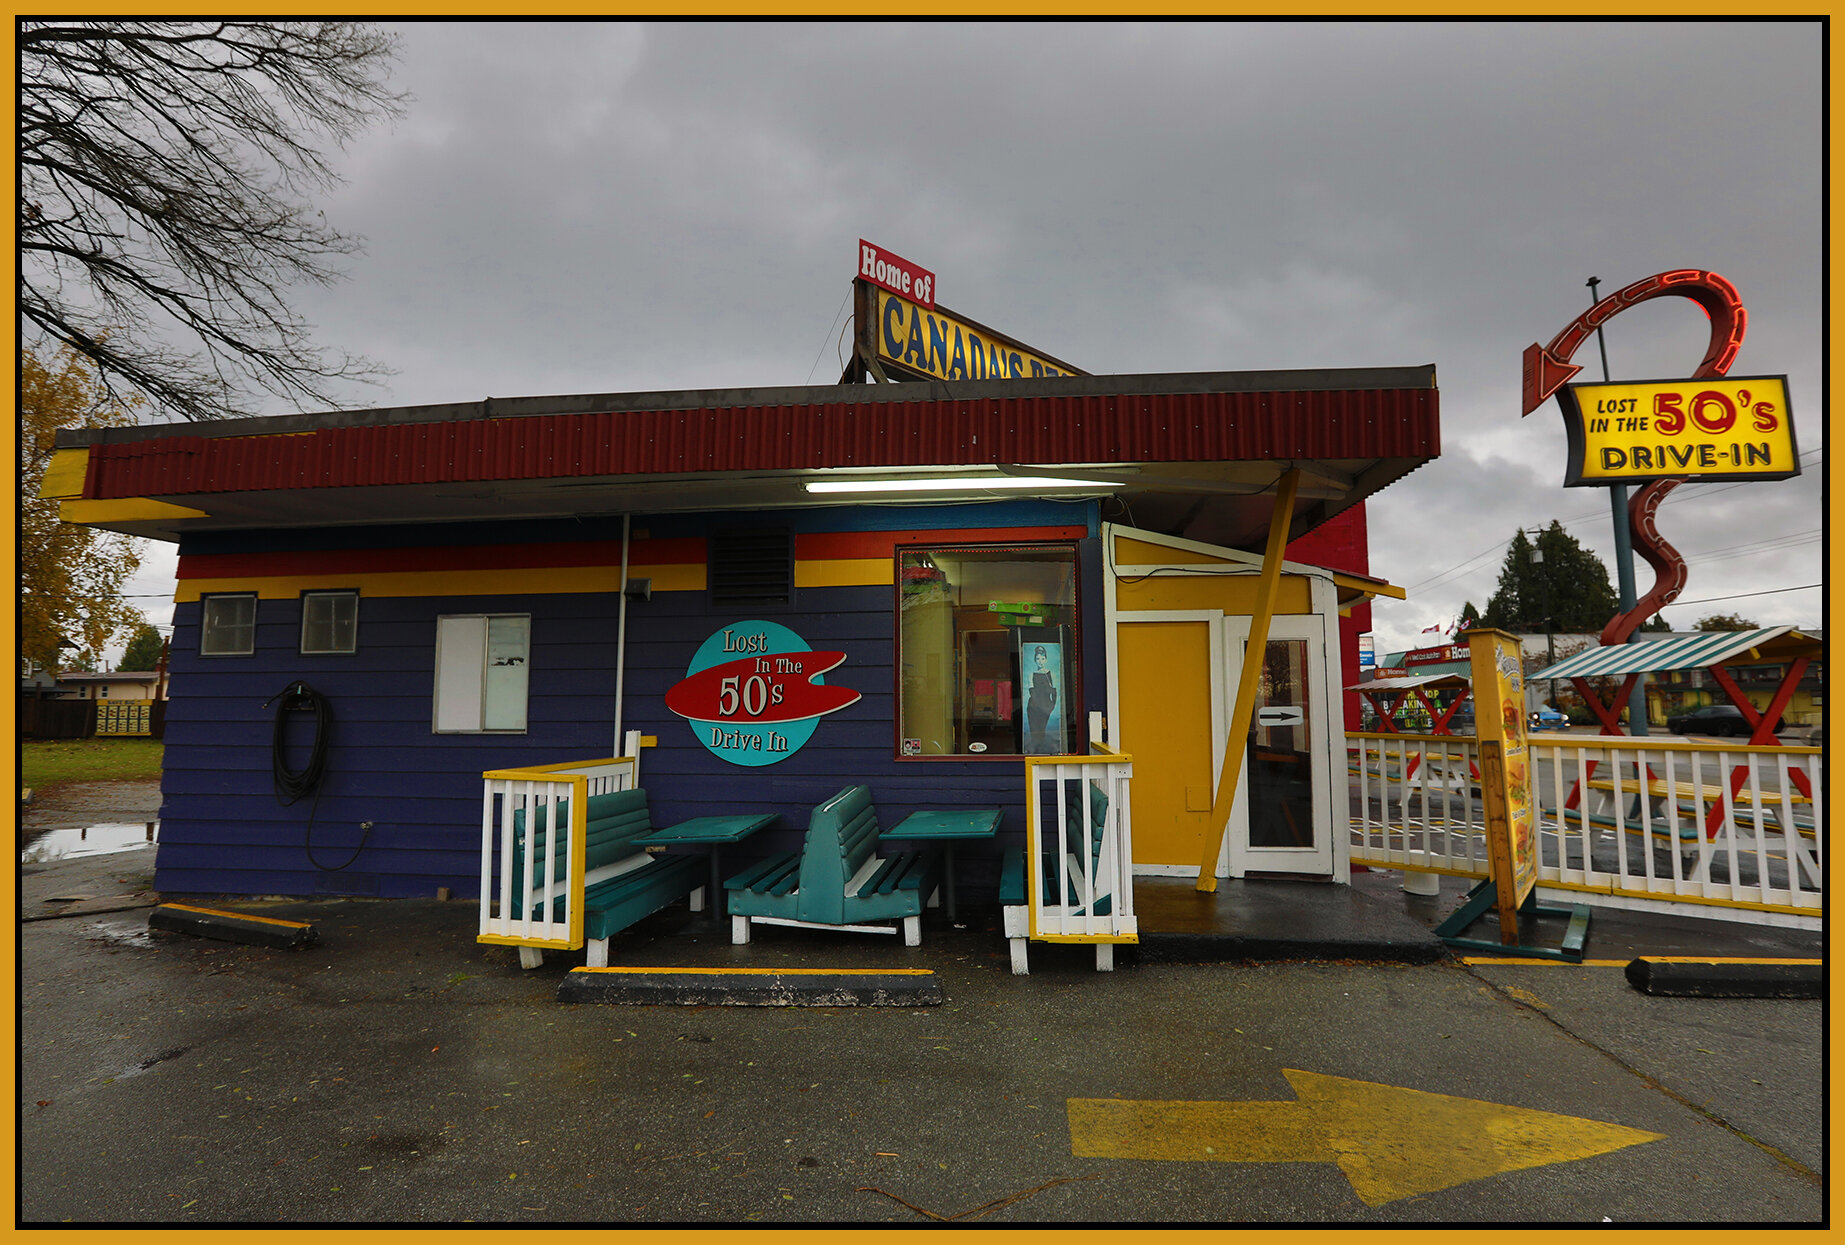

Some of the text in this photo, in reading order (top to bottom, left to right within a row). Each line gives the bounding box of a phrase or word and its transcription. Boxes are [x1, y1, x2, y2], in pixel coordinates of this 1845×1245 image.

[861, 245, 932, 304] Home of
[1596, 398, 1638, 414] LOST
[1589, 416, 1648, 433] IN THE
[1601, 442, 1772, 470] DRIVE-IN
[722, 630, 768, 653] Lost
[1451, 646, 1471, 659] Hom
[755, 658, 803, 674] In The
[719, 675, 784, 716] 50's
[710, 727, 788, 751] Drive In
